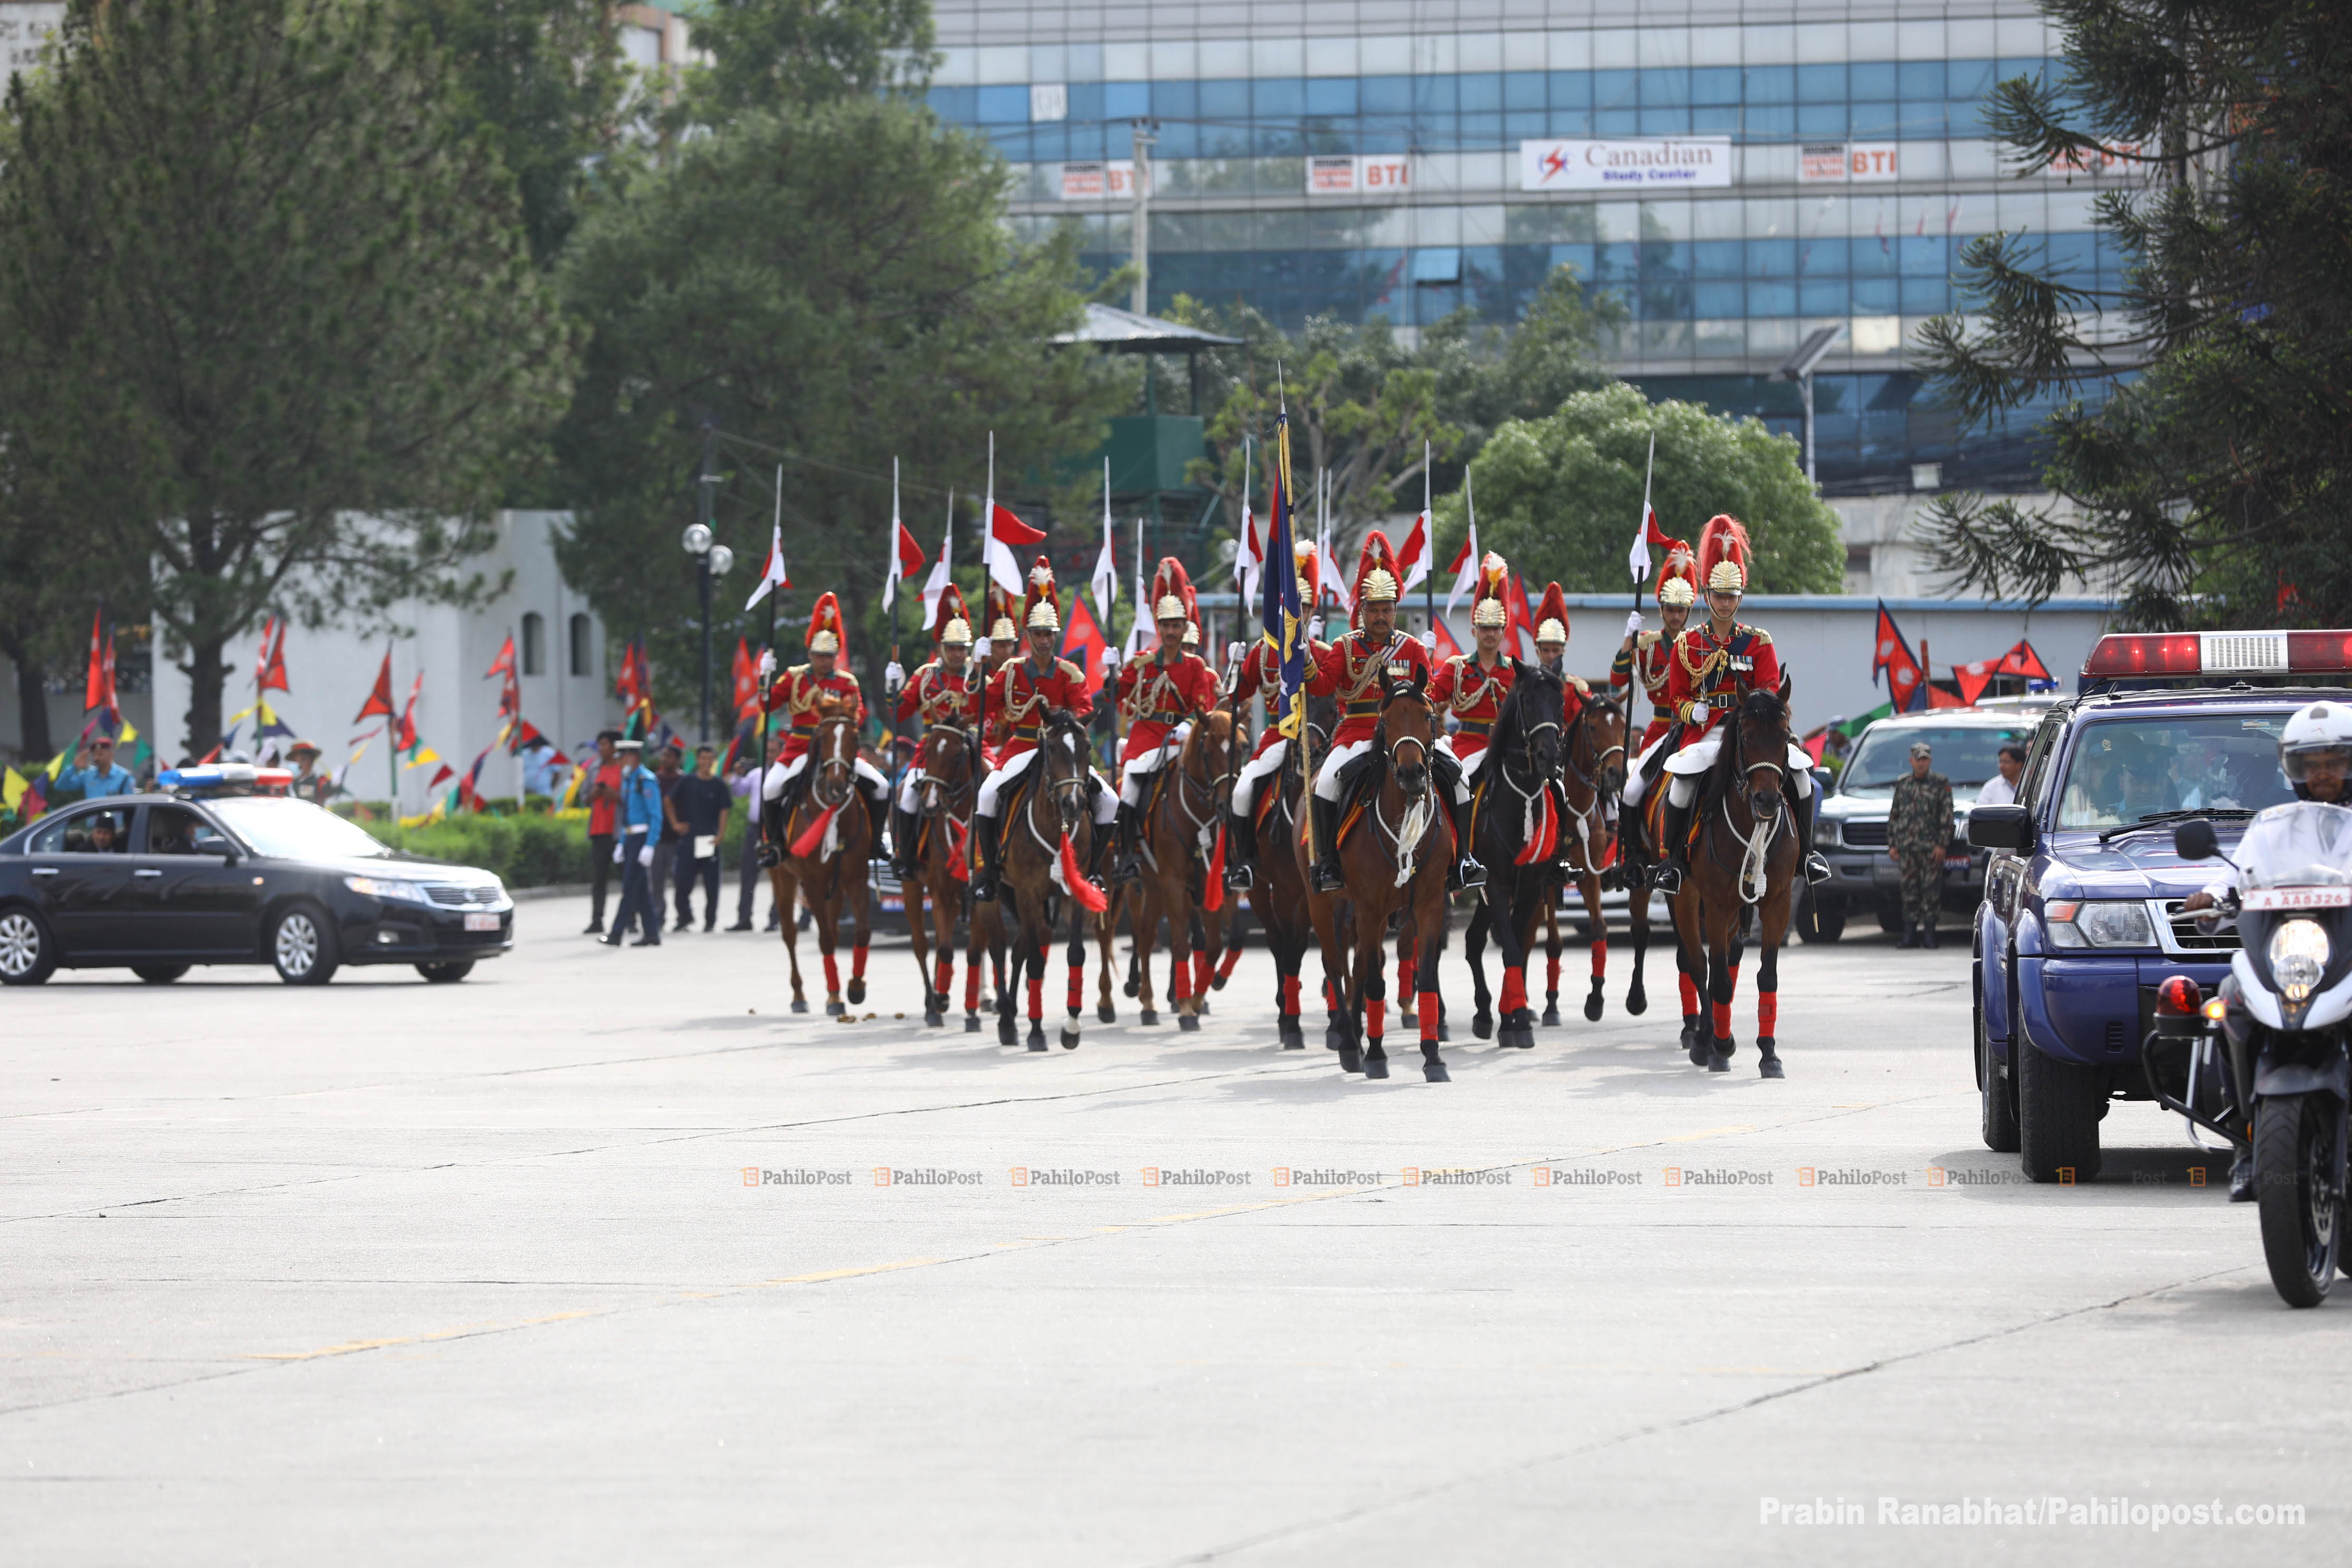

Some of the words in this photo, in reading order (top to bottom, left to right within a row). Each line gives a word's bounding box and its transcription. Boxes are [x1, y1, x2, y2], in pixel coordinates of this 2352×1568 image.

[1585, 141, 1713, 167] Canadian
[1852, 151, 1896, 173] BTI
[1368, 165, 1408, 185] BTI
[1603, 170, 1642, 182] Study
[1648, 168, 1696, 179] Center
[2282, 894, 2343, 905] AA8326
